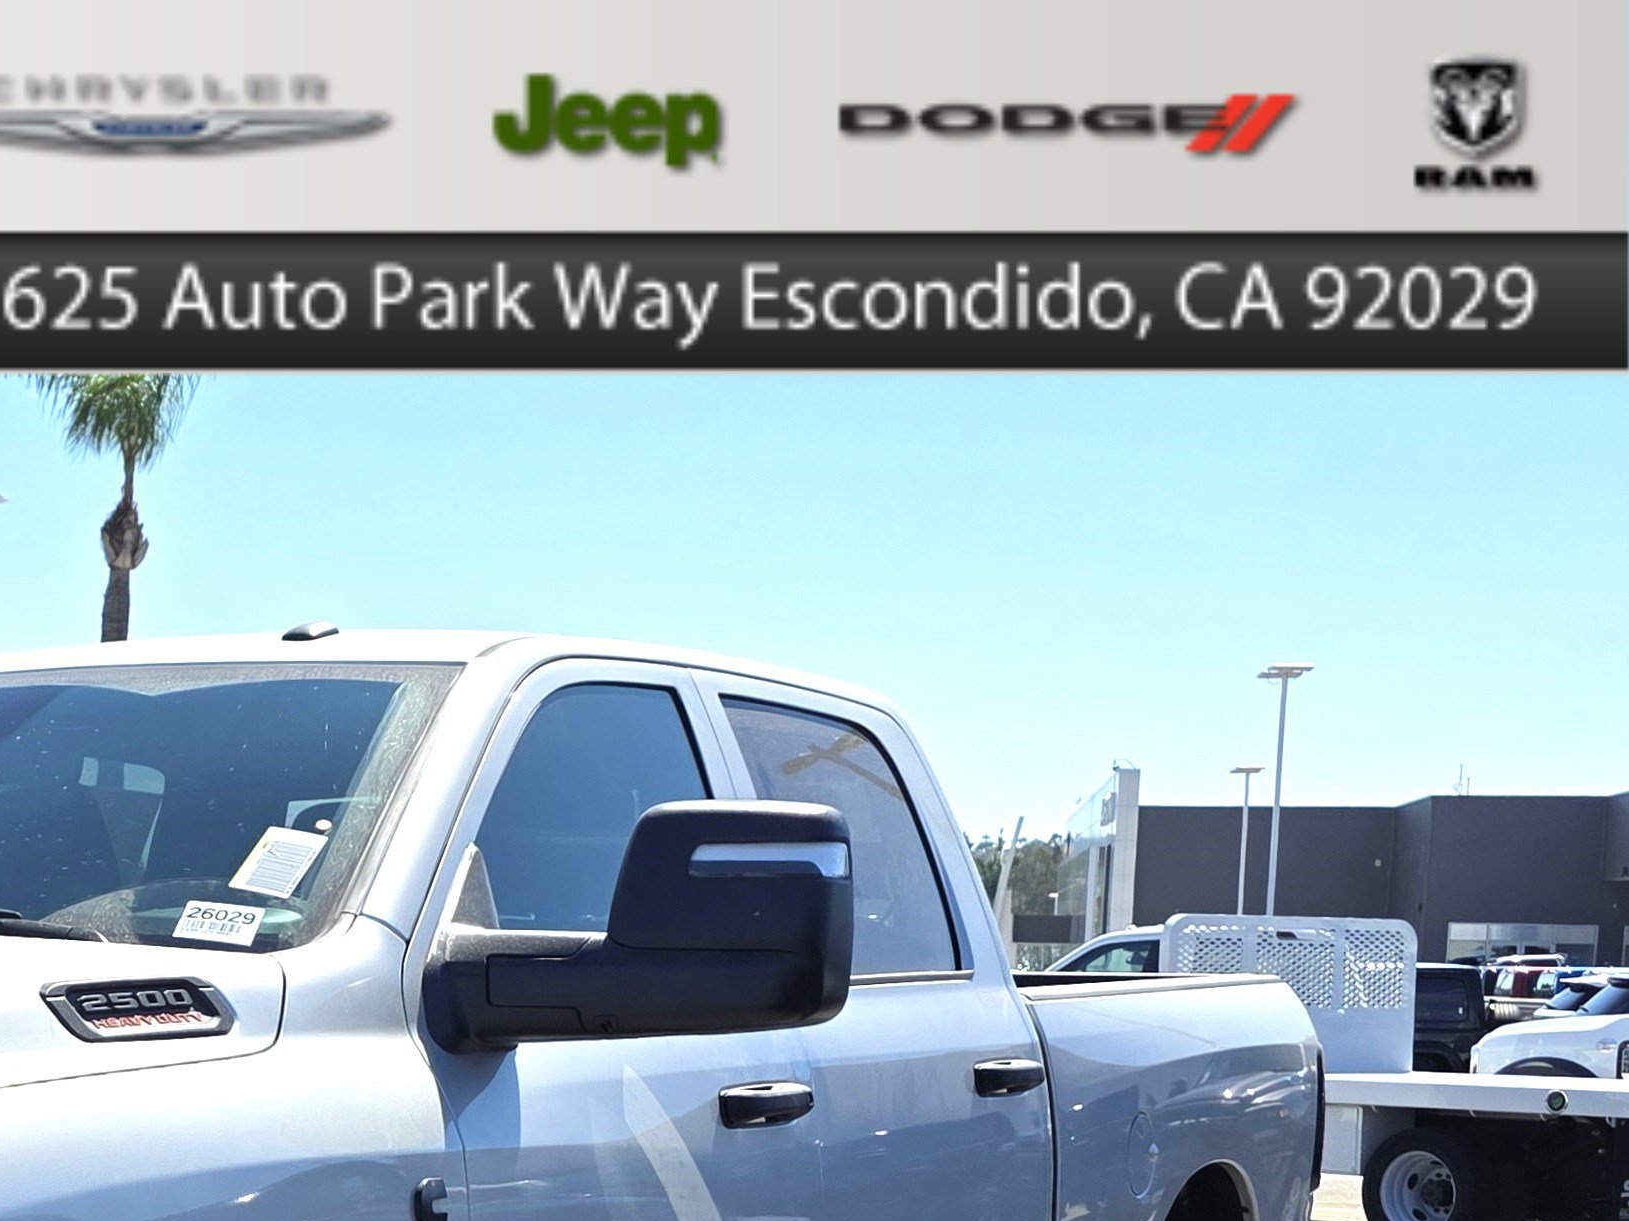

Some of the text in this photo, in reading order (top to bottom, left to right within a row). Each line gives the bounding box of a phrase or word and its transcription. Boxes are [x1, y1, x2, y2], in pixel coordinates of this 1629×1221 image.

[186, 906, 256, 925] 26029
[76, 988, 194, 1012] 2500
[90, 1014, 154, 1030] HEAVY
